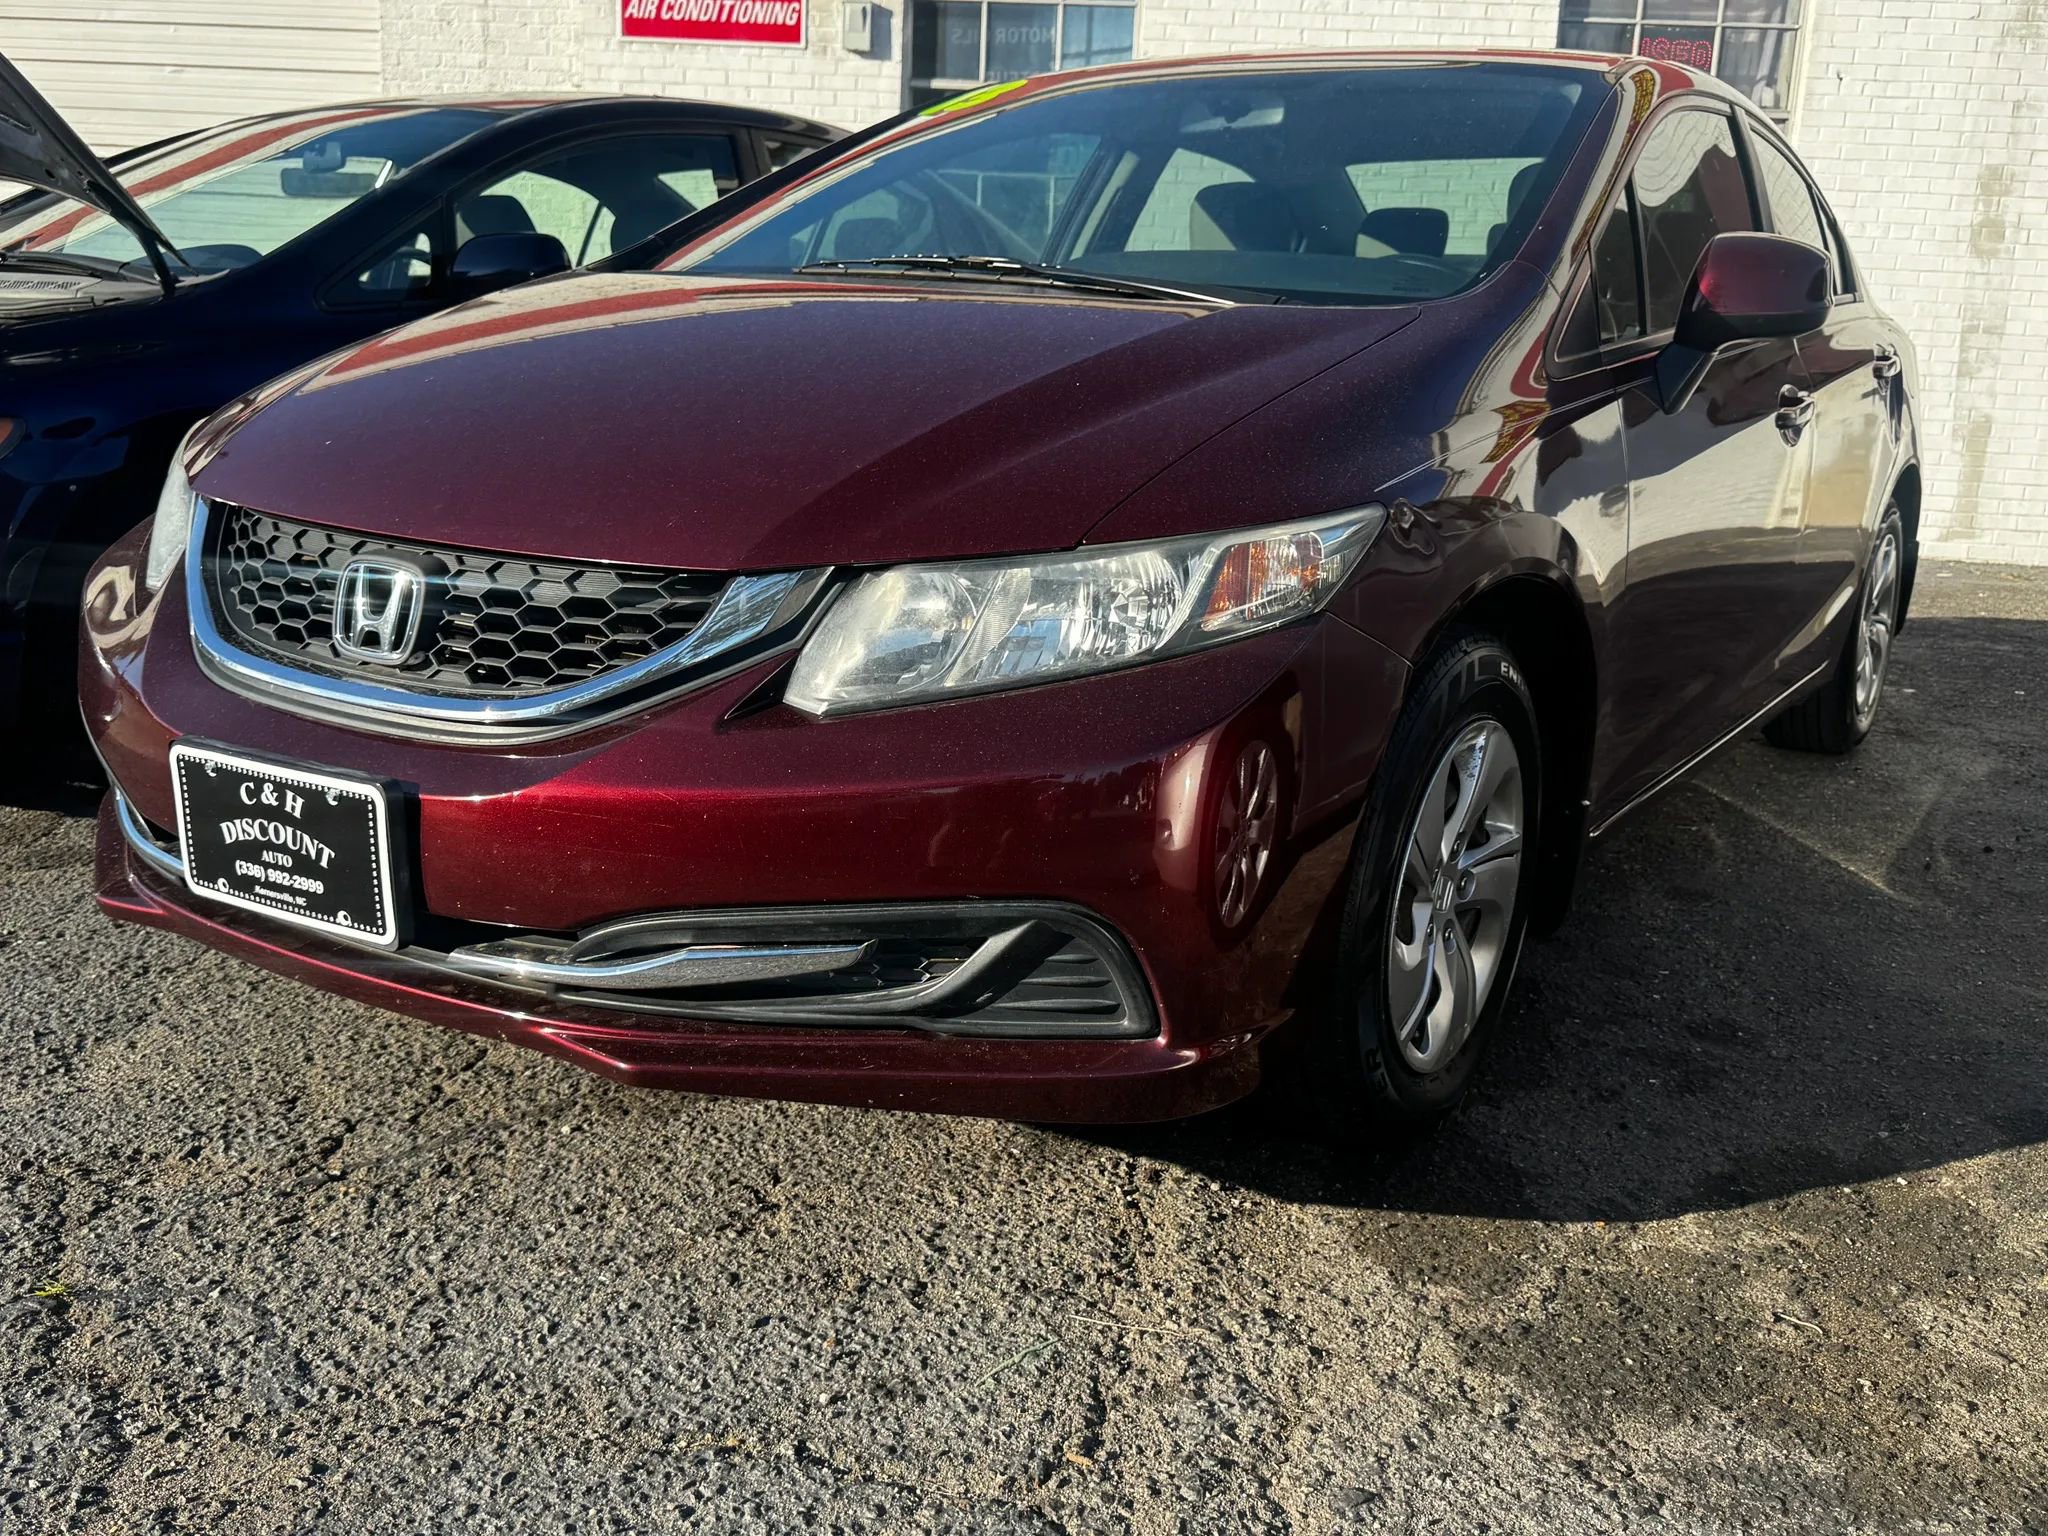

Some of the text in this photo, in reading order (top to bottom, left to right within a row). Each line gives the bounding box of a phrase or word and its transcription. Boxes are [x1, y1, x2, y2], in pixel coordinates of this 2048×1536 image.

[624, 0, 799, 26] AIR CONDITIONING
[240, 782, 305, 819] C & H
[219, 818, 336, 869] DISCOUNT
[261, 850, 293, 868] AUTO
[235, 860, 325, 895] (336) 992-2999
